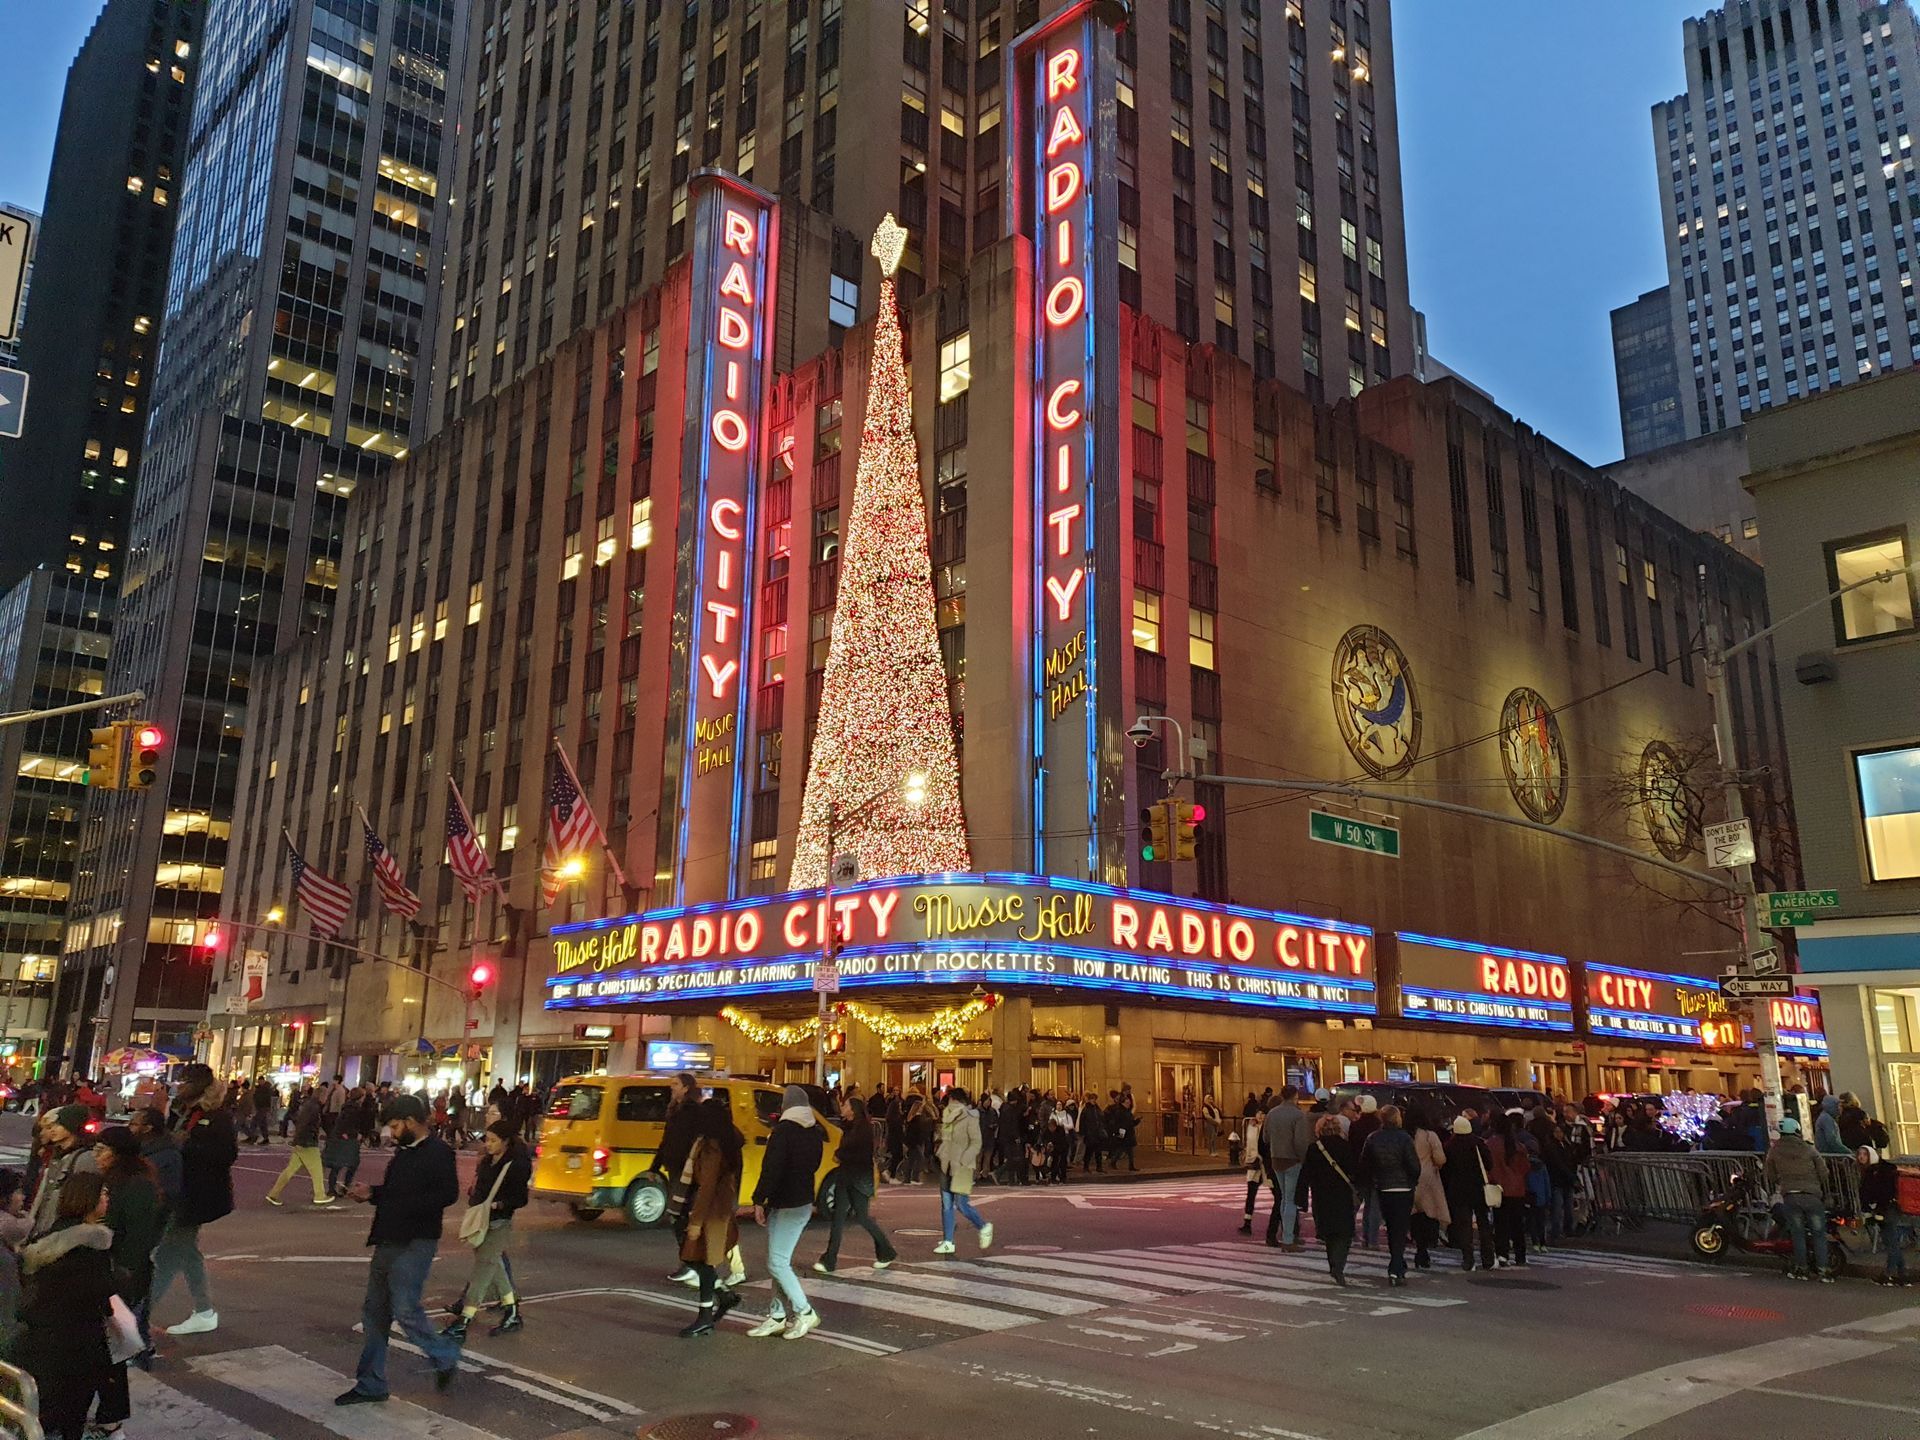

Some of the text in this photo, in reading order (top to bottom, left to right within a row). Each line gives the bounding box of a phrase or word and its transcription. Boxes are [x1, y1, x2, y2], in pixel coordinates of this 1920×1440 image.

[1045, 48, 1084, 621] RADIO CITY
[701, 208, 753, 698] RADIO CITY
[694, 712, 734, 748] MUSIC
[697, 745, 732, 778] HALL
[1333, 822, 1376, 847] W 50 St
[1706, 822, 1747, 838] DON'T BLOCK
[1714, 836, 1726, 845] THE
[1774, 895, 1835, 908] AMERICAS
[1780, 911, 1804, 925] 6 AV
[553, 891, 1367, 975] Music Hall RADIO CITY Music Hall RADIO CITY
[577, 983, 593, 997] THE
[599, 977, 651, 995] CHRISTMAS
[657, 970, 733, 990] SPECTACULAR
[739, 964, 796, 985] STARRING
[837, 957, 876, 976] RADIO
[884, 953, 922, 972] CITY
[936, 953, 1055, 973] ROCKETTES
[1073, 958, 1105, 978] NOW
[1113, 963, 1170, 985] PLAYING
[1186, 970, 1212, 989] THIS
[1219, 975, 1231, 991] IS
[1238, 977, 1301, 998] CHRISTMAS
[1307, 983, 1318, 999] IN
[1482, 957, 1567, 999] RADIO
[1730, 981, 1783, 991] ONE WAY
[1433, 998, 1453, 1013] THIS
[1457, 1000, 1466, 1014] IS
[1469, 1002, 1515, 1018] CHRISTMAS
[1600, 974, 1652, 1010] CITY
[1772, 1001, 1811, 1030] ADIO
